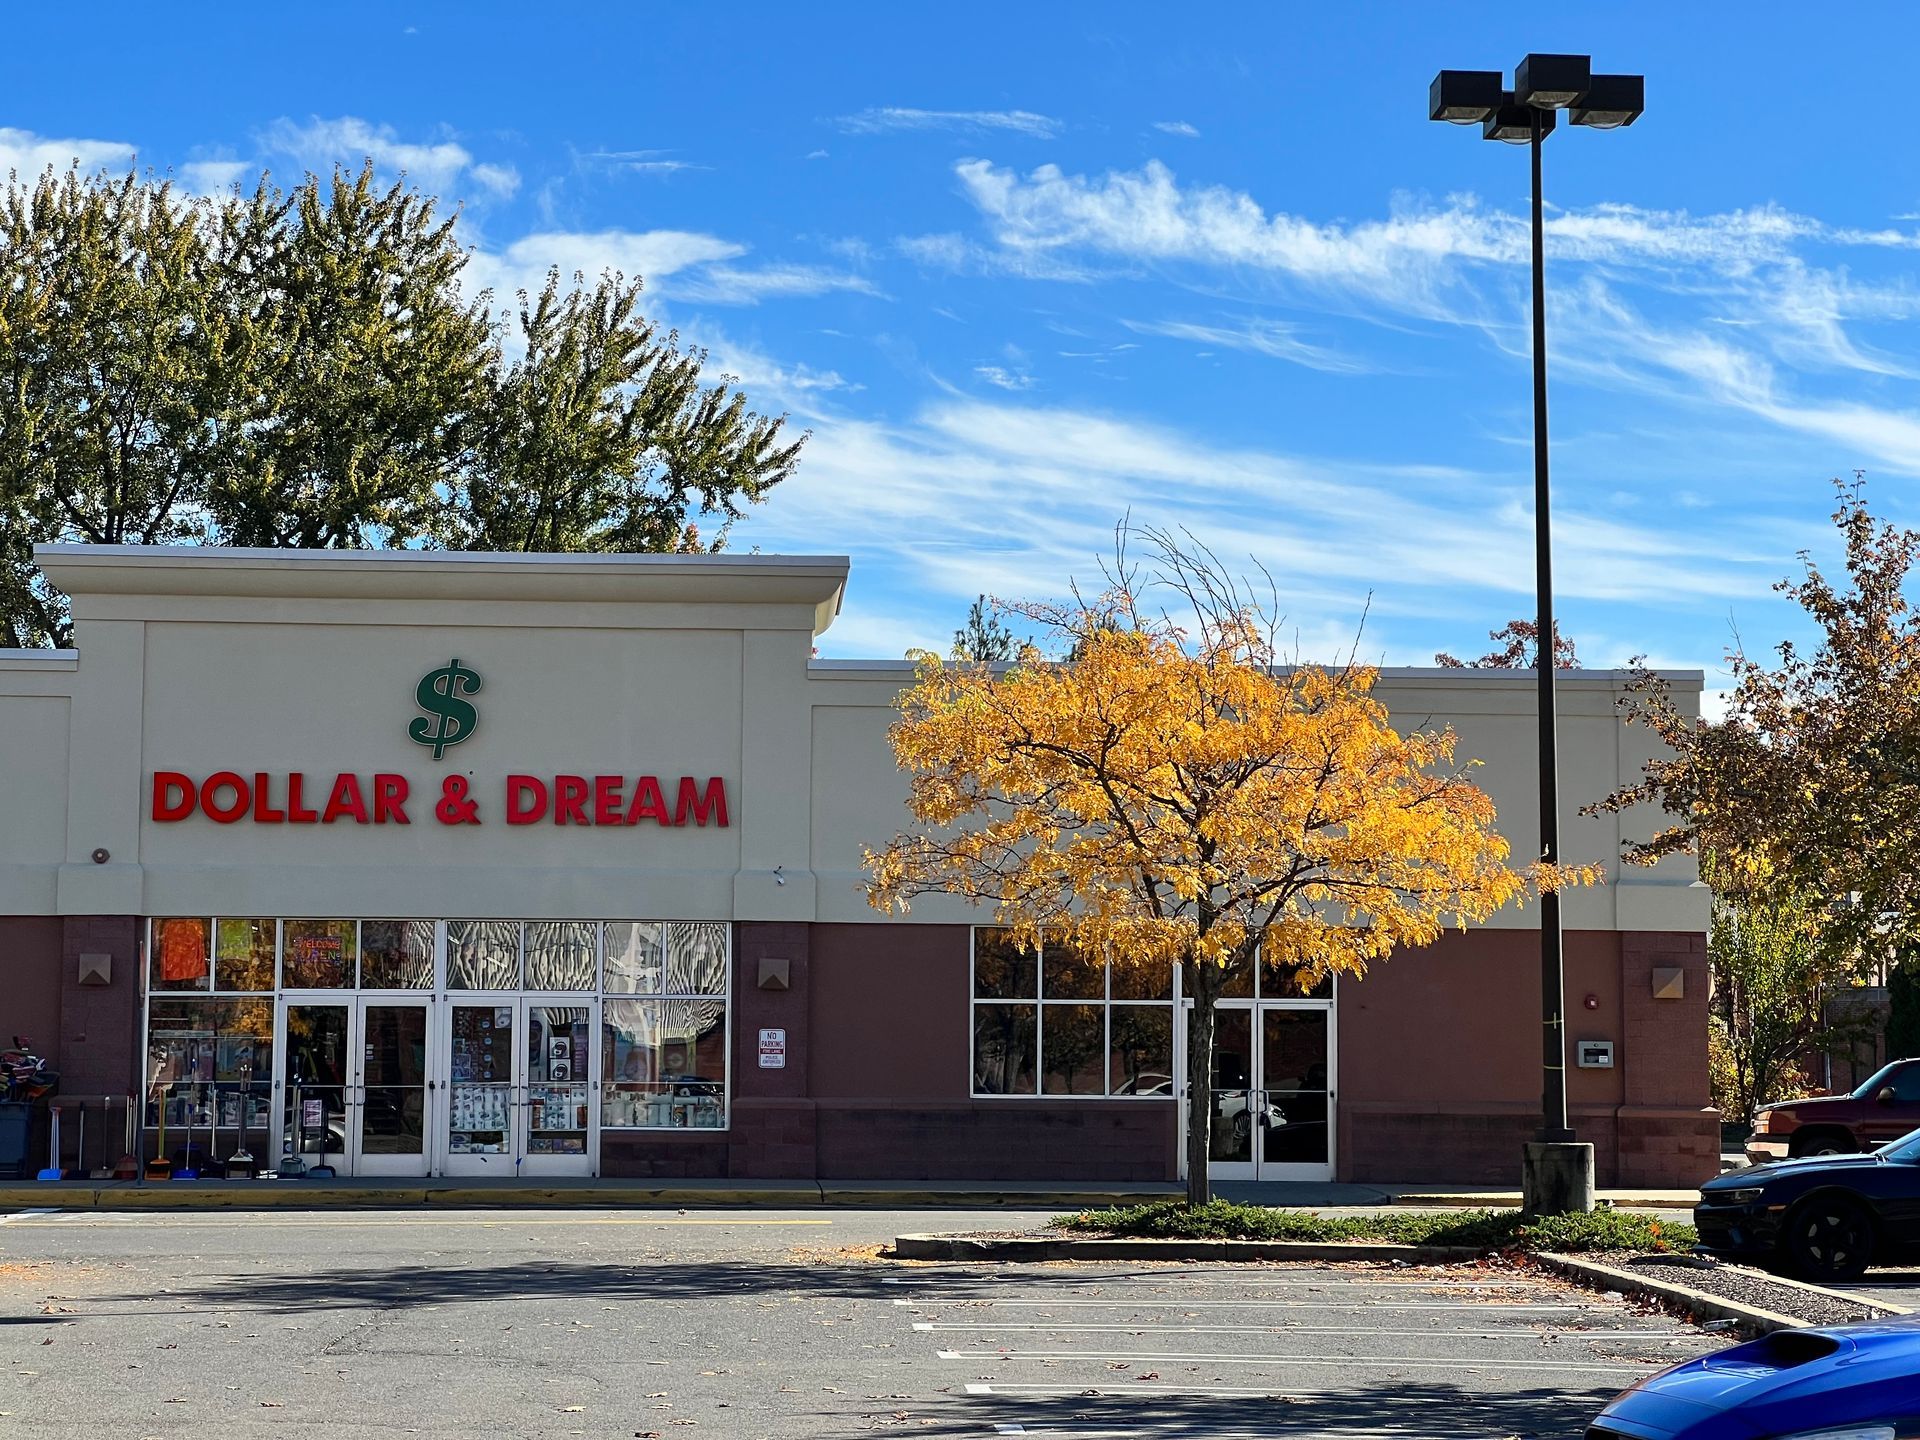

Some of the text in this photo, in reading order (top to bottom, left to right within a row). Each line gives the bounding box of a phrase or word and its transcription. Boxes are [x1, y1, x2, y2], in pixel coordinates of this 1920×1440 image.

[407, 657, 483, 760] $
[151, 771, 731, 829] DOLLAR & DREAM
[761, 1040, 783, 1048] PARKING
[767, 1032, 777, 1040] NO
